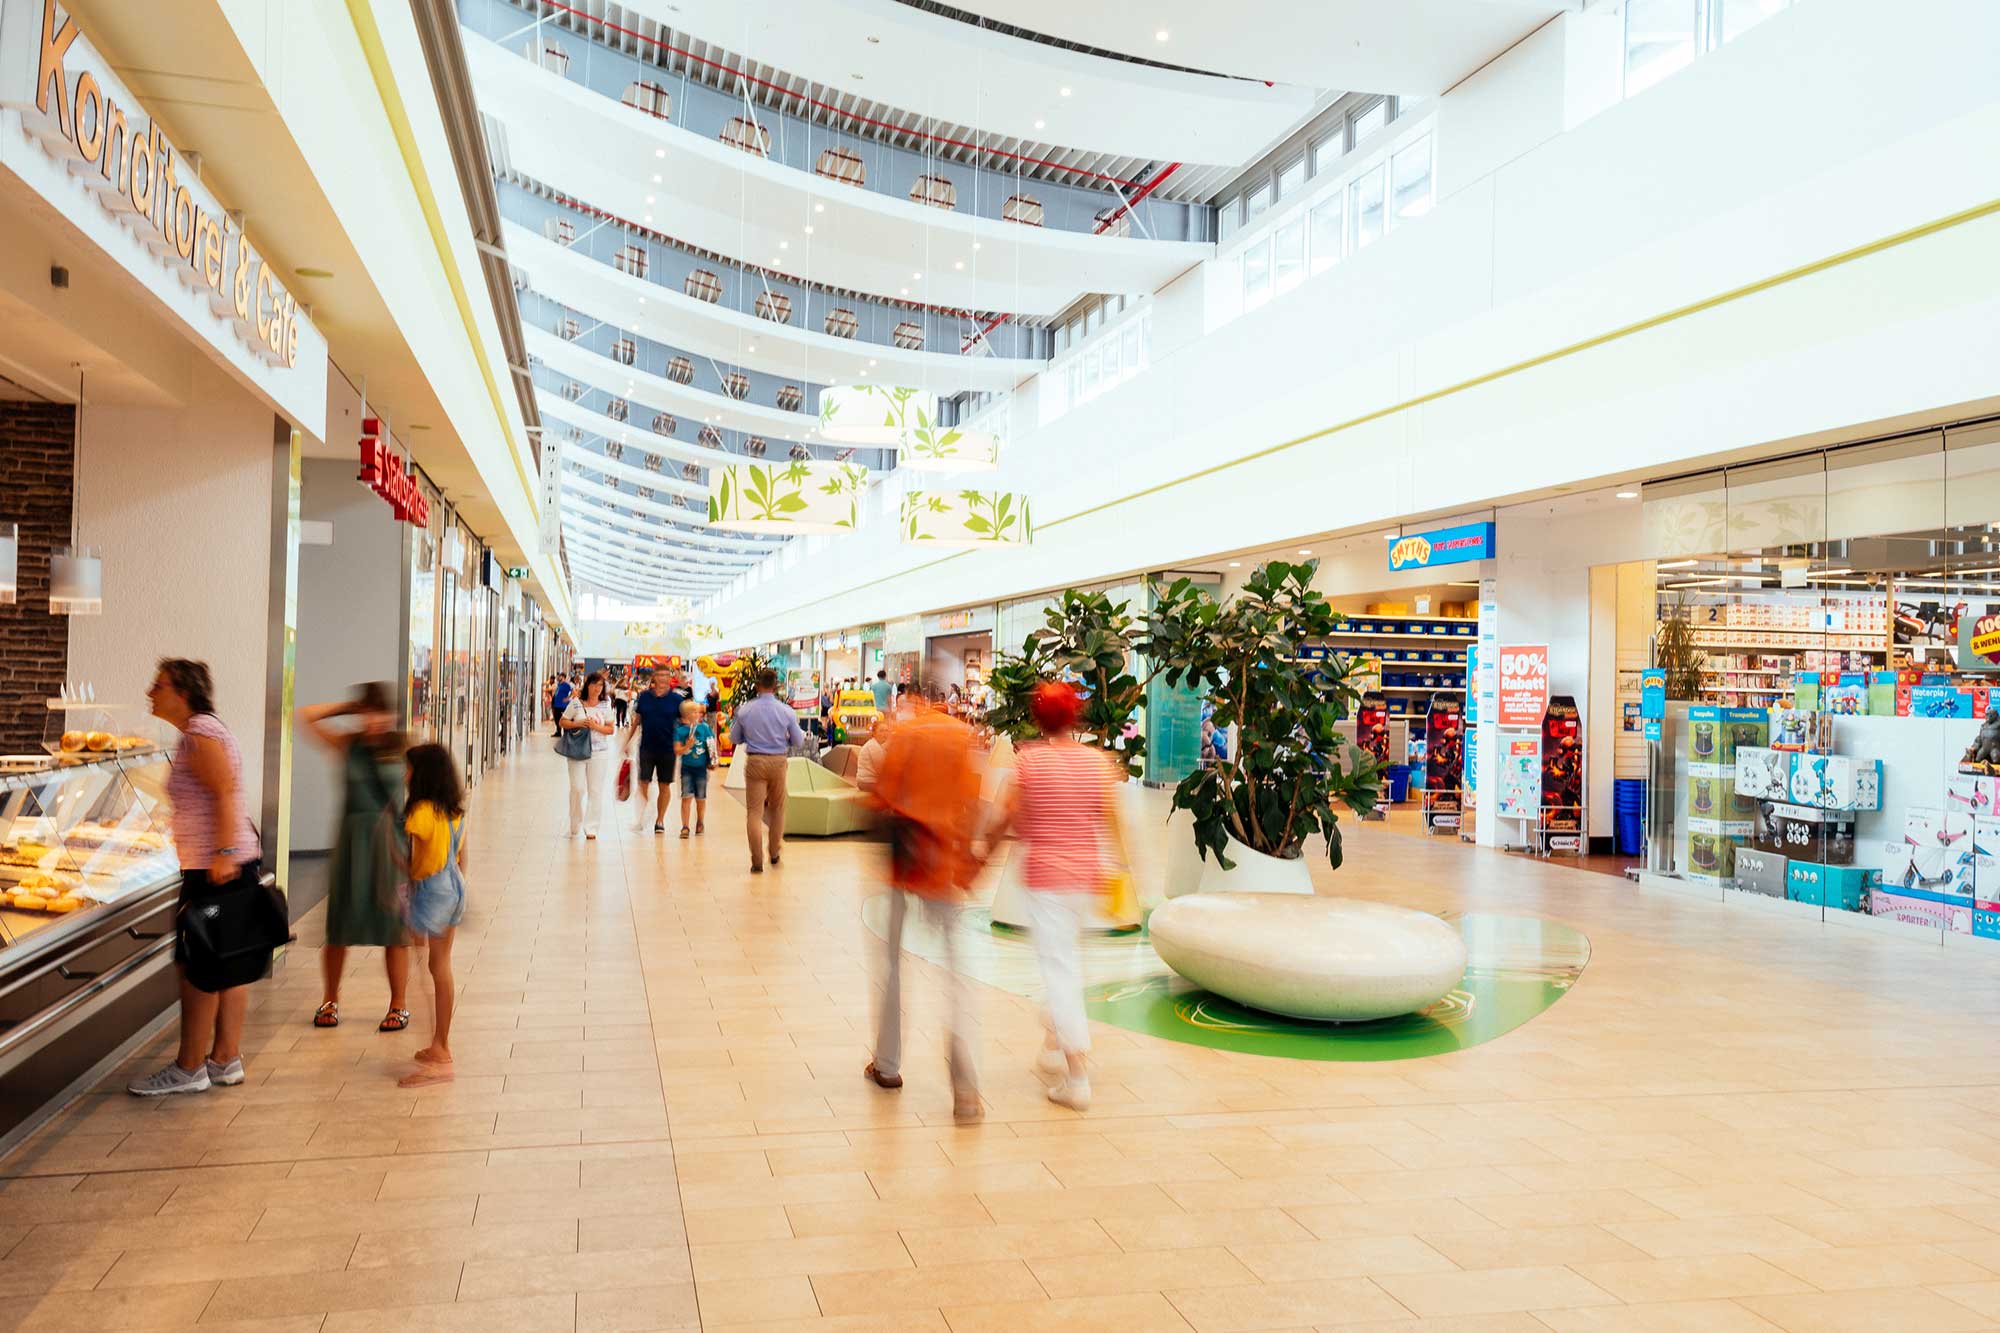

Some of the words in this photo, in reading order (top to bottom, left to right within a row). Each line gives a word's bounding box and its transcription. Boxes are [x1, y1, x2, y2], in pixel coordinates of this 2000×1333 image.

[36, 0, 229, 297] Konditorei
[233, 233, 251, 321] &
[256, 261, 298, 369] Café
[1391, 540, 1429, 566] SMYTHS
[1708, 608, 1717, 621] 2
[1501, 653, 1547, 676] 50%
[1502, 676, 1545, 690] Rabatt
[1912, 688, 1948, 698] Waterplay
